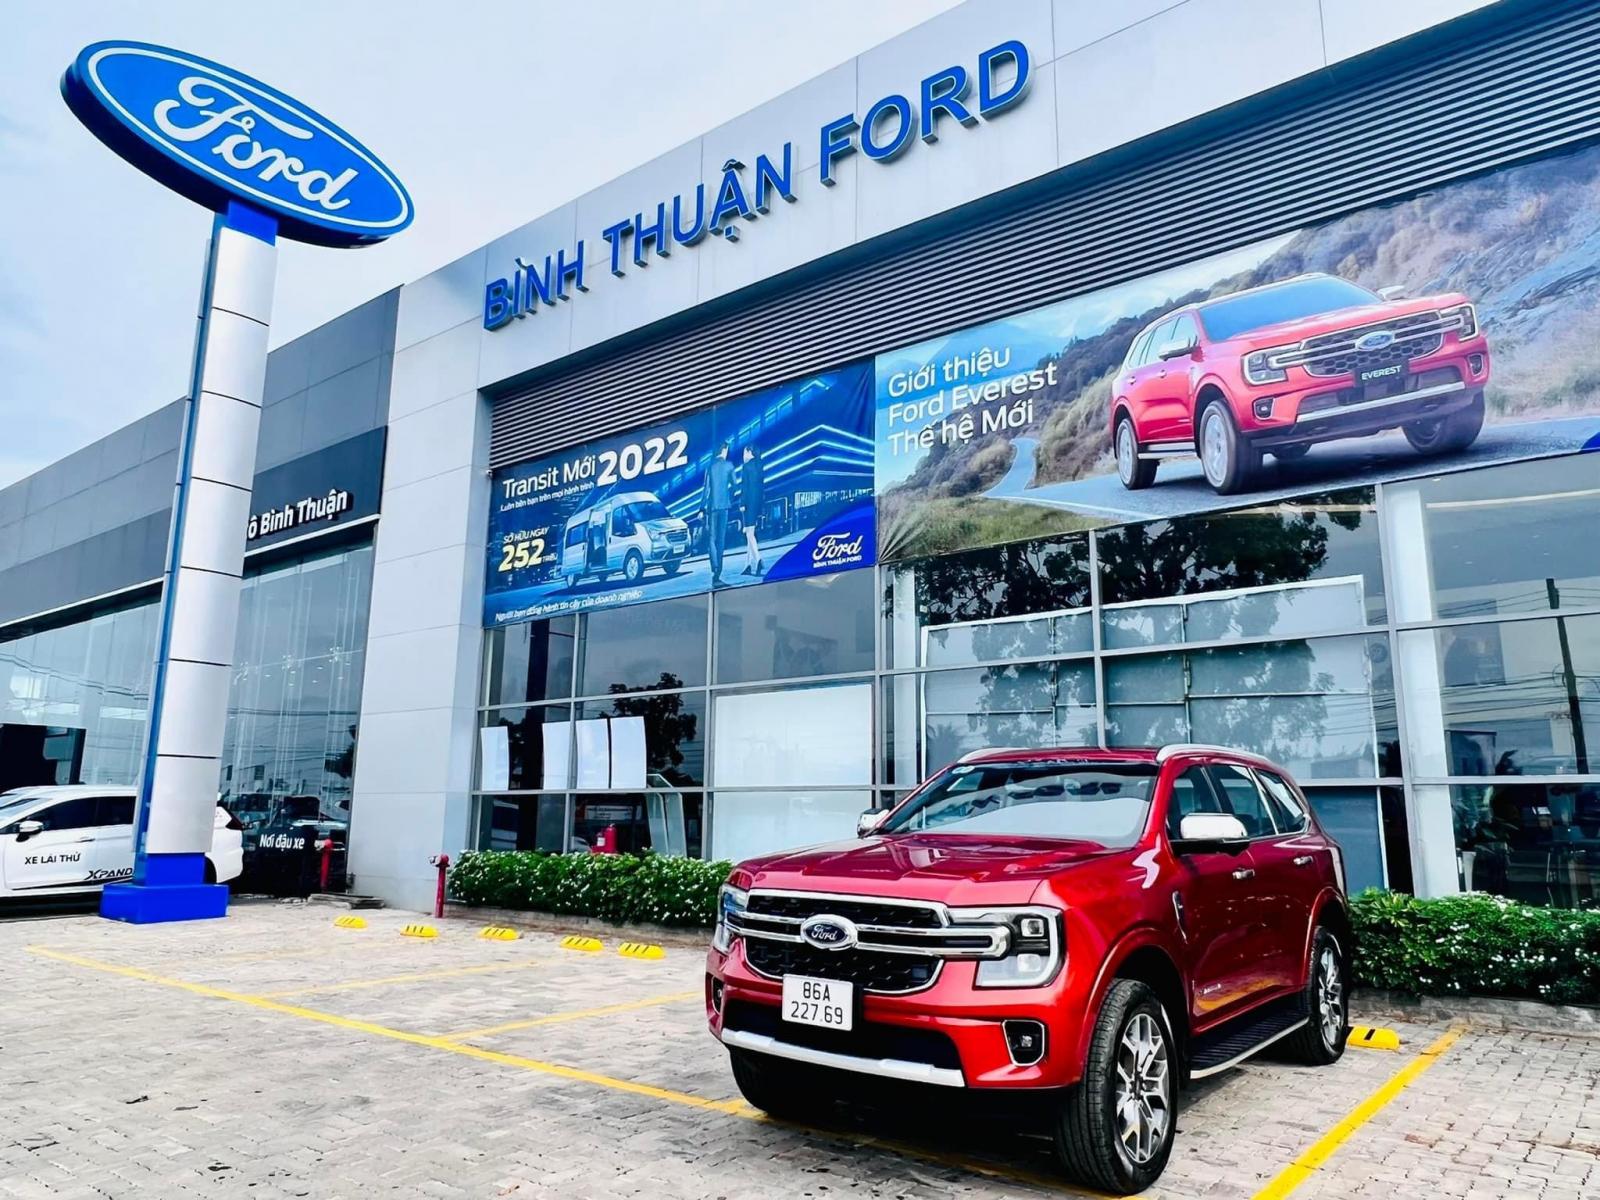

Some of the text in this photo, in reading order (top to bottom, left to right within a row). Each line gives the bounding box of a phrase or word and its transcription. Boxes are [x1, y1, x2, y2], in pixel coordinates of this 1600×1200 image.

[154, 76, 359, 210] Ford
[483, 40, 1031, 332] BÌNH THUẬN FORD
[888, 347, 1011, 398] Giới thiệu
[1361, 365, 1401, 380] EVEREST
[889, 362, 1058, 428] Ford Everest
[887, 399, 1034, 457] Thế hệ Mới
[502, 430, 689, 499] Transit Mới 2022
[297, 488, 348, 523] Thuận
[498, 538, 545, 572] 252
[812, 532, 863, 561] Ford
[292, 838, 305, 849] xe
[24, 857, 38, 865] XE
[811, 924, 838, 941] Ford
[803, 981, 831, 1002] 86A
